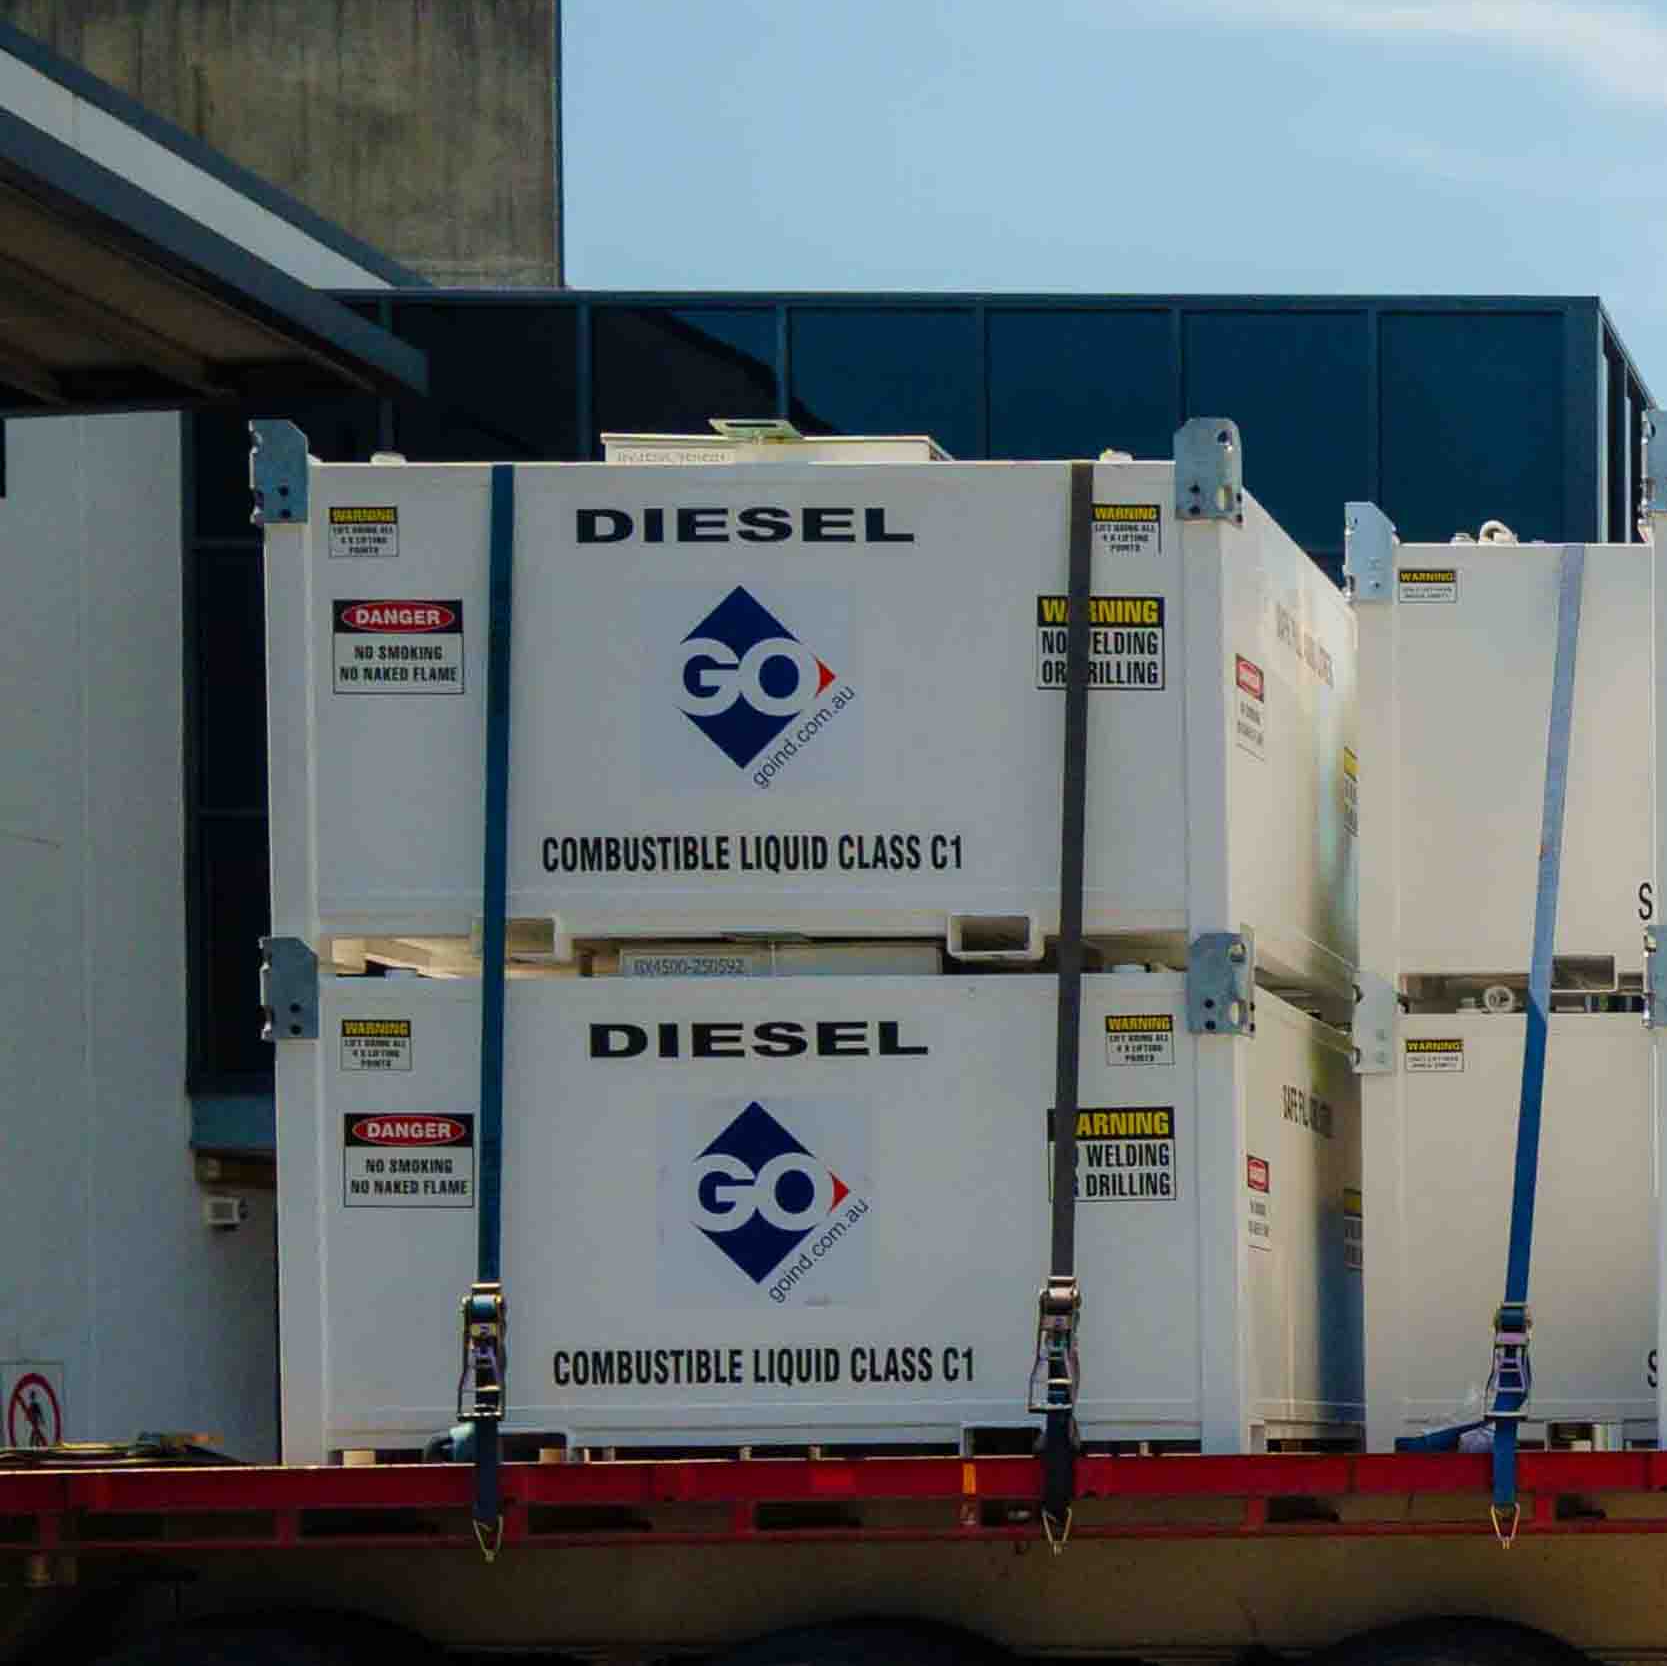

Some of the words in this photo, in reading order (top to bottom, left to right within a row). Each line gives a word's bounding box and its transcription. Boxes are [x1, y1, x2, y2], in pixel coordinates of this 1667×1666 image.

[576, 508, 914, 543] DIESEL
[355, 609, 441, 625] DANGER
[666, 637, 820, 717] GO
[752, 685, 855, 789] goind.com.au
[543, 836, 729, 872] COMBUSTIBLE
[741, 835, 827, 873] LIQUID
[839, 835, 921, 869] CLASS
[932, 835, 961, 869] C1
[590, 1021, 928, 1057] DIESEL
[366, 1122, 451, 1139] DANGER
[366, 1159, 384, 1173] NO
[389, 1159, 452, 1173] SMOKING
[1086, 1143, 1169, 1167] WELDING
[351, 1180, 369, 1194] NO
[374, 1181, 419, 1194] NAKED
[424, 1181, 467, 1194] FLAME
[680, 1152, 833, 1231] GO
[1086, 1172, 1170, 1197] DRILLING
[768, 1198, 868, 1305] goind.com.au
[554, 1349, 742, 1386] COMBUSTIBLE
[754, 1349, 840, 1386] LIQUID
[851, 1347, 932, 1382] CLASS
[943, 1347, 972, 1381] C1
